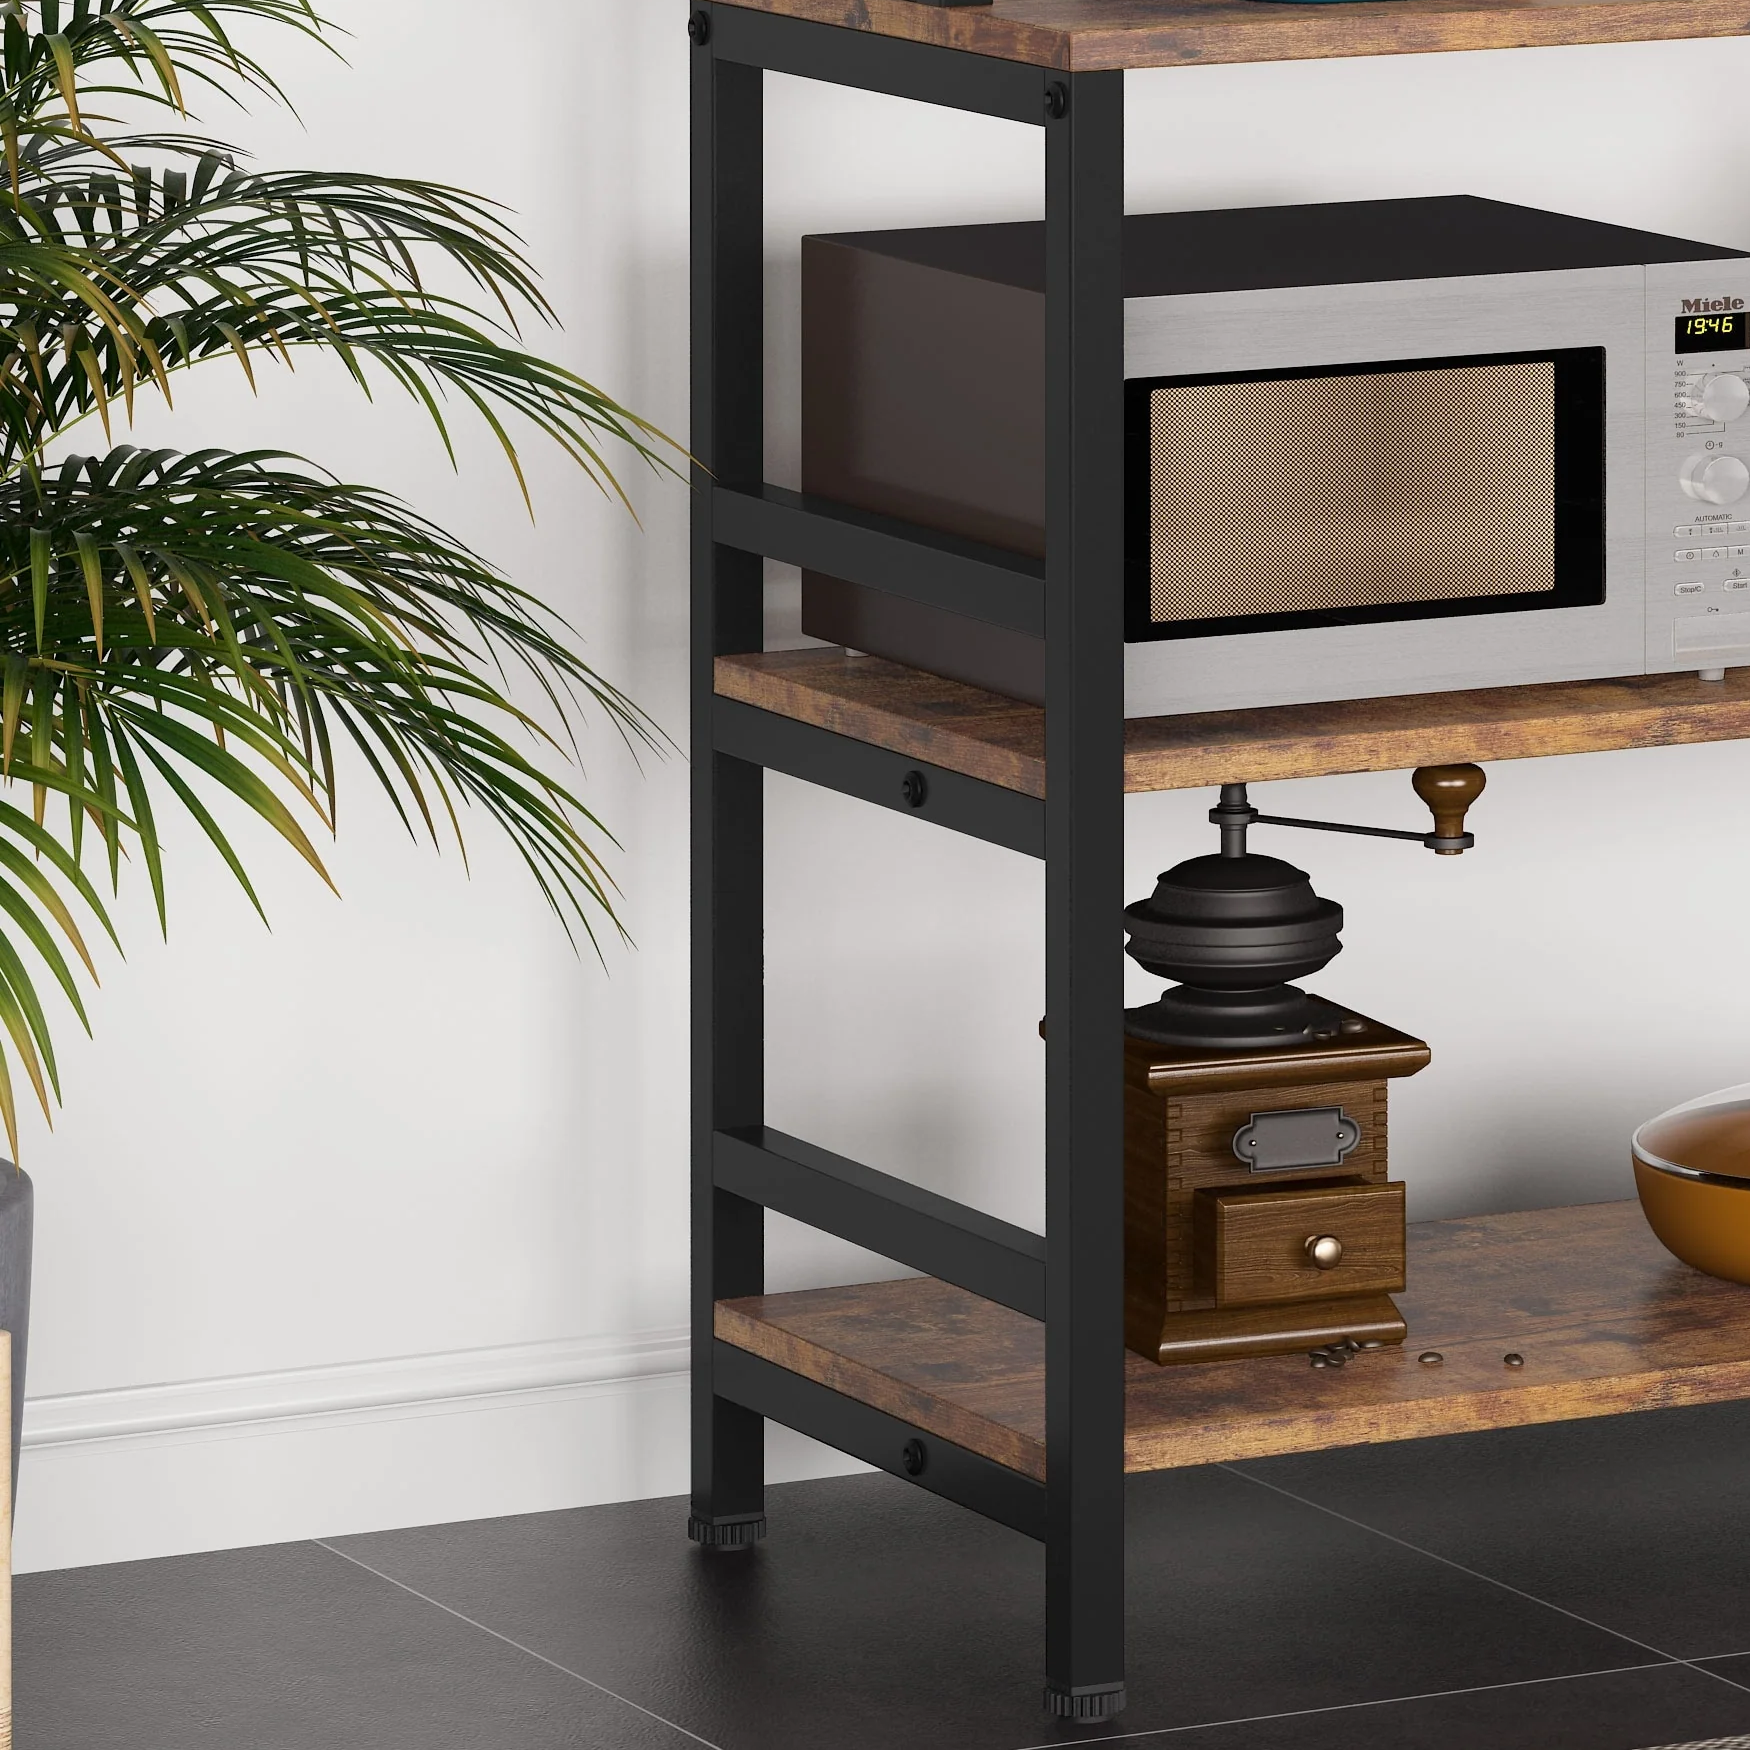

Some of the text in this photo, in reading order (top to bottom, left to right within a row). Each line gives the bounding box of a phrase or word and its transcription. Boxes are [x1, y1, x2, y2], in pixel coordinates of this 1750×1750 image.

[1681, 296, 1744, 313] Miele
[1687, 316, 1733, 334] 19:46
[1695, 514, 1732, 522] AUTOMATIC
